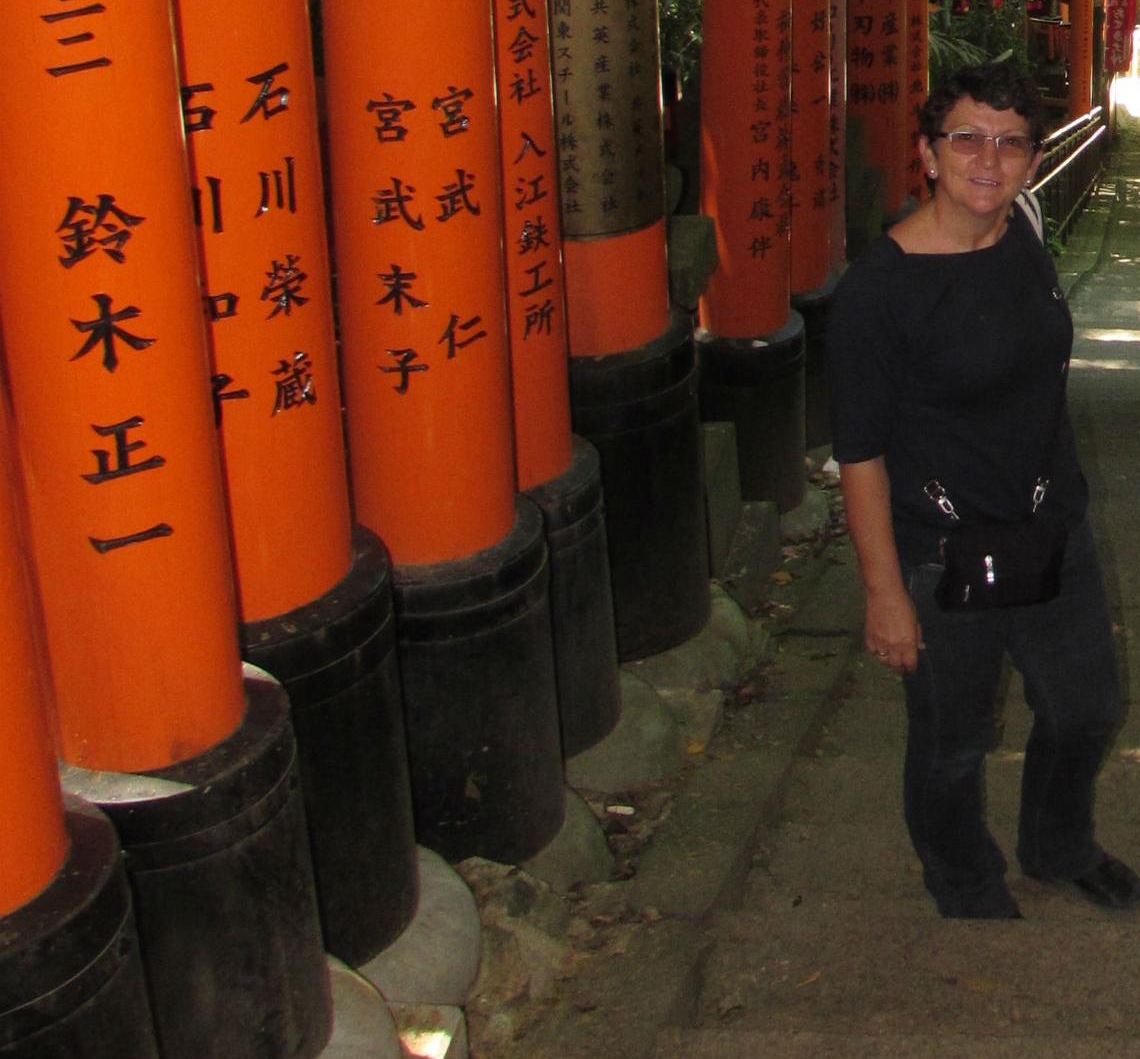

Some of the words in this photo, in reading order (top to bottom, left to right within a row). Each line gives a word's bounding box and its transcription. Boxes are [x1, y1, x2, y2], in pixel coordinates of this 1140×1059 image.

[431, 85, 488, 358] 宮武仁
[512, 130, 556, 341] 入江鉄工所
[56, 194, 174, 554] 鈴木正一
